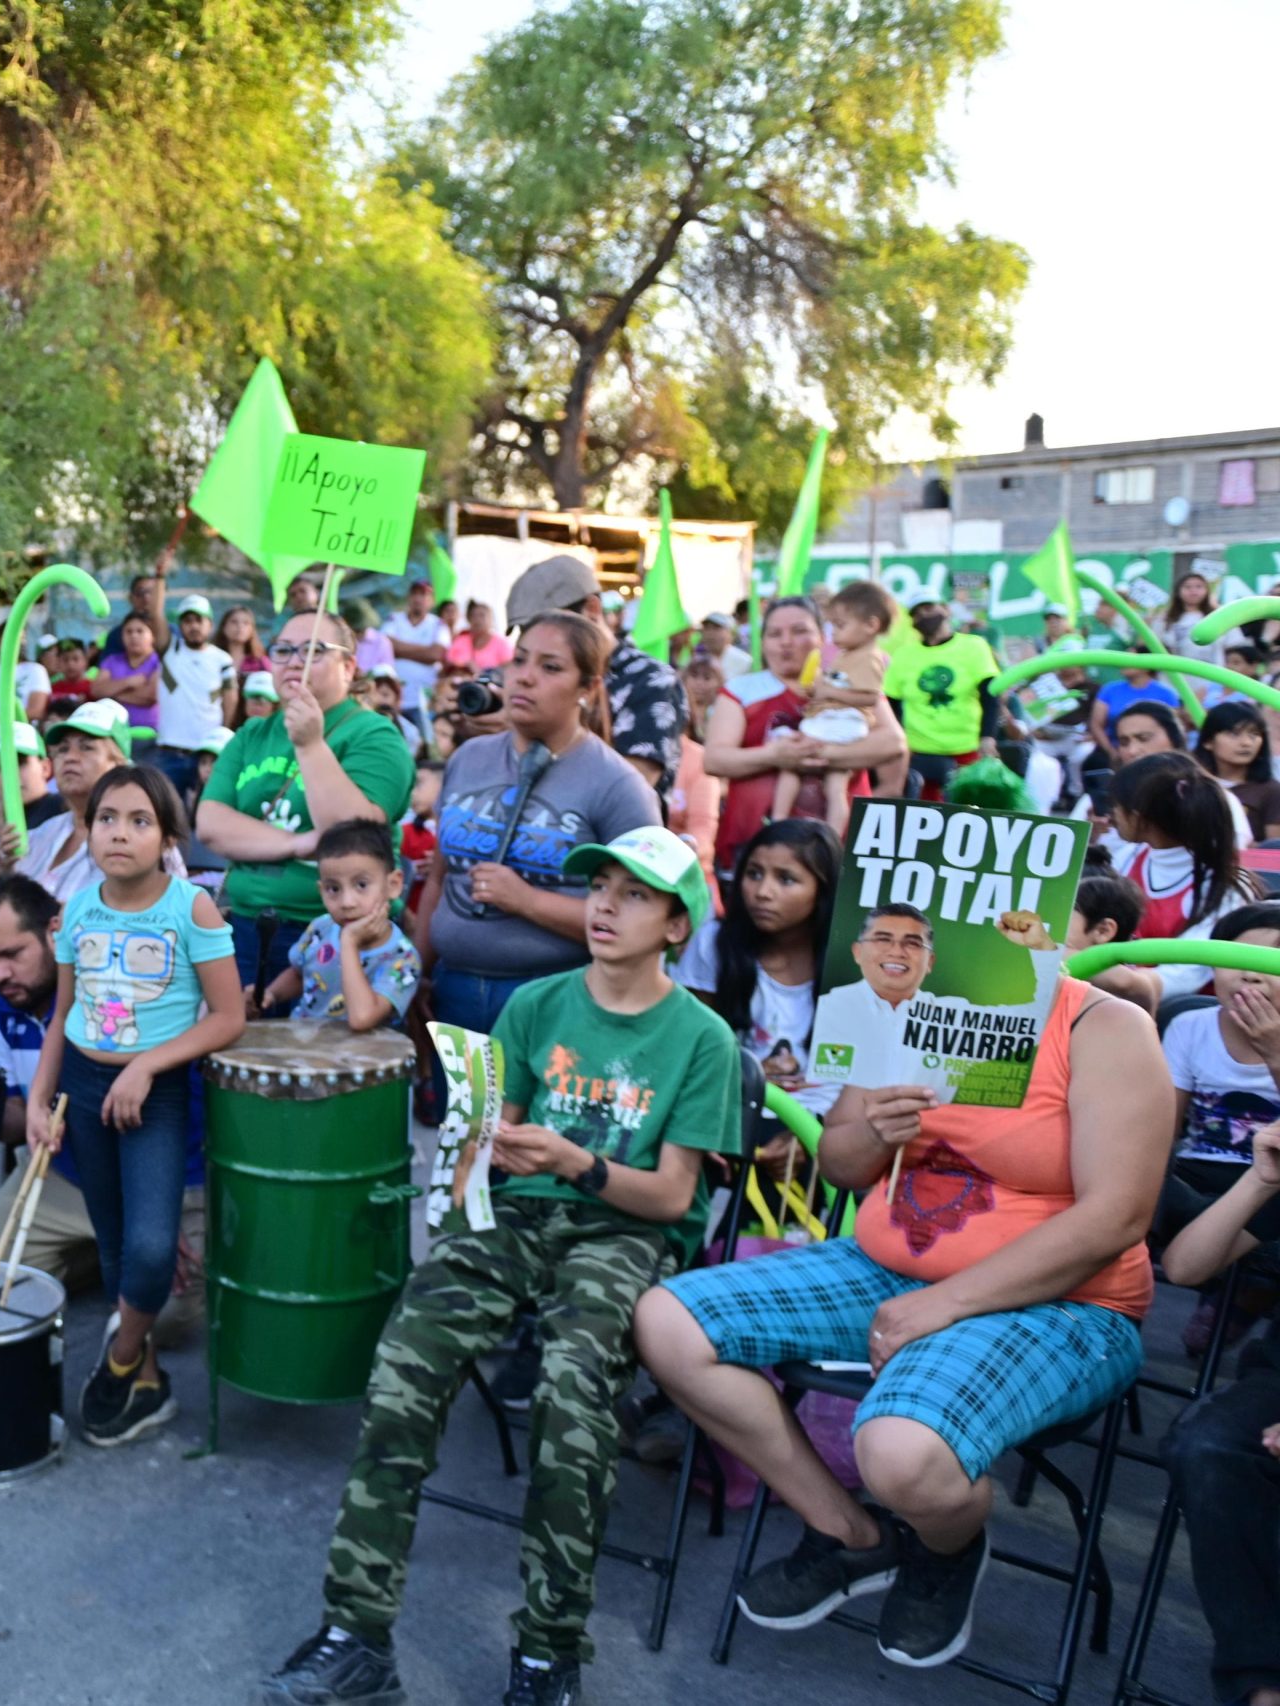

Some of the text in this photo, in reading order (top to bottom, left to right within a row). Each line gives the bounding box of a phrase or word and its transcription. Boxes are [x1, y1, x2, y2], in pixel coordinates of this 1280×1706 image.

[852, 803, 1076, 878] APOYO
[856, 856, 1051, 933] TOTAL
[908, 1001, 1037, 1036] JUAN MANUEL
[903, 1019, 1036, 1063] NAVARRO
[943, 1057, 1029, 1079] PRESIDENTE
